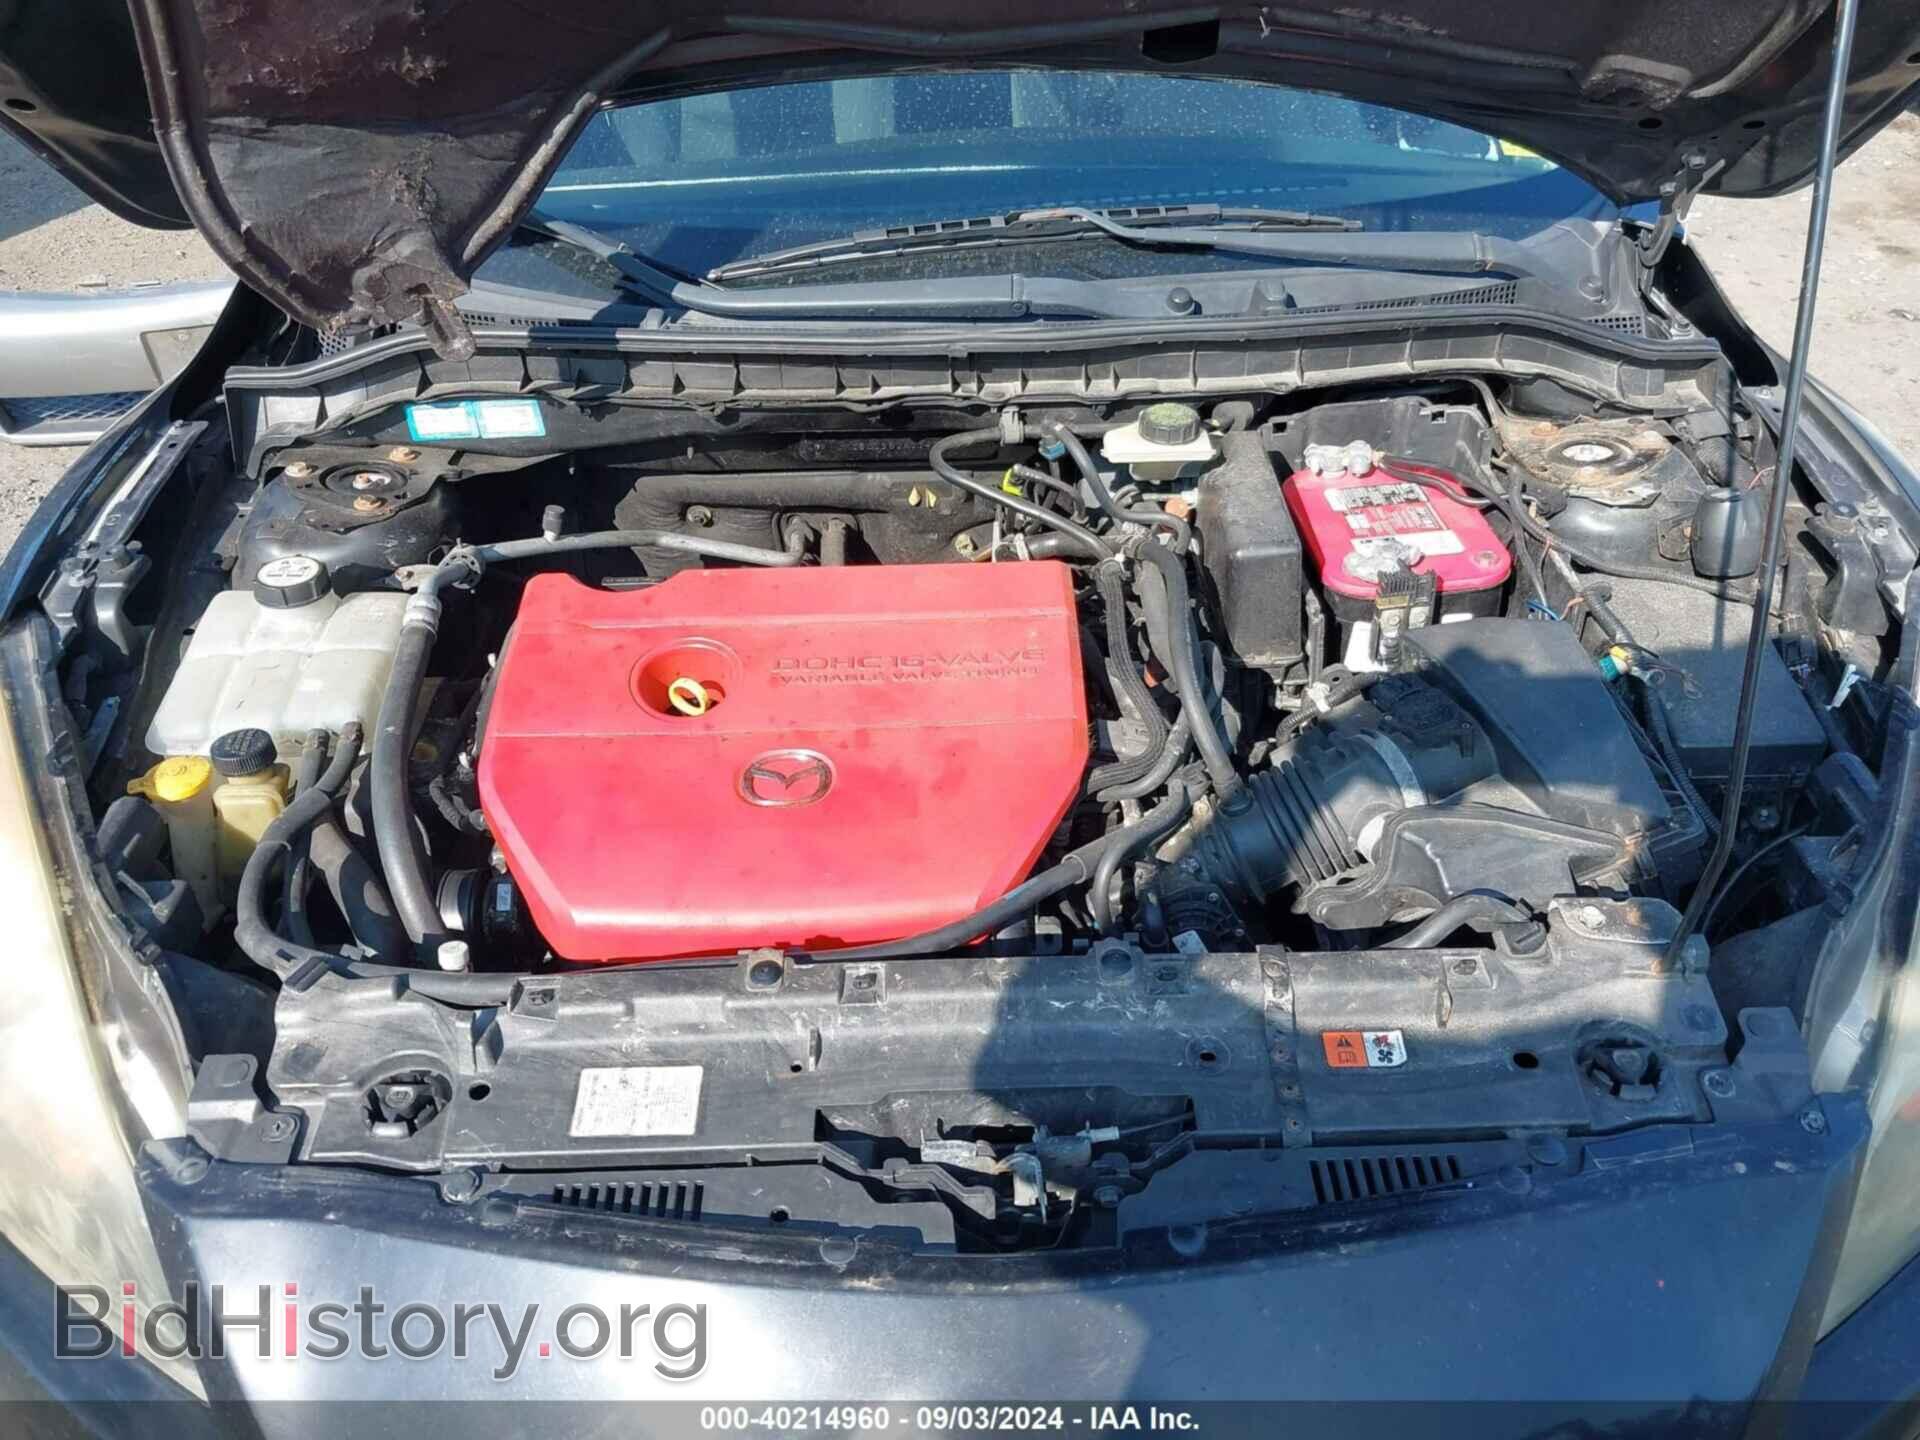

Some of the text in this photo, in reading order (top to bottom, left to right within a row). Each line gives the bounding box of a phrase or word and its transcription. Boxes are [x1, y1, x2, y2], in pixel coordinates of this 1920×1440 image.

[776, 648, 1046, 670] DOHC 16-VALVE
[779, 673, 885, 685] VARIABLE
